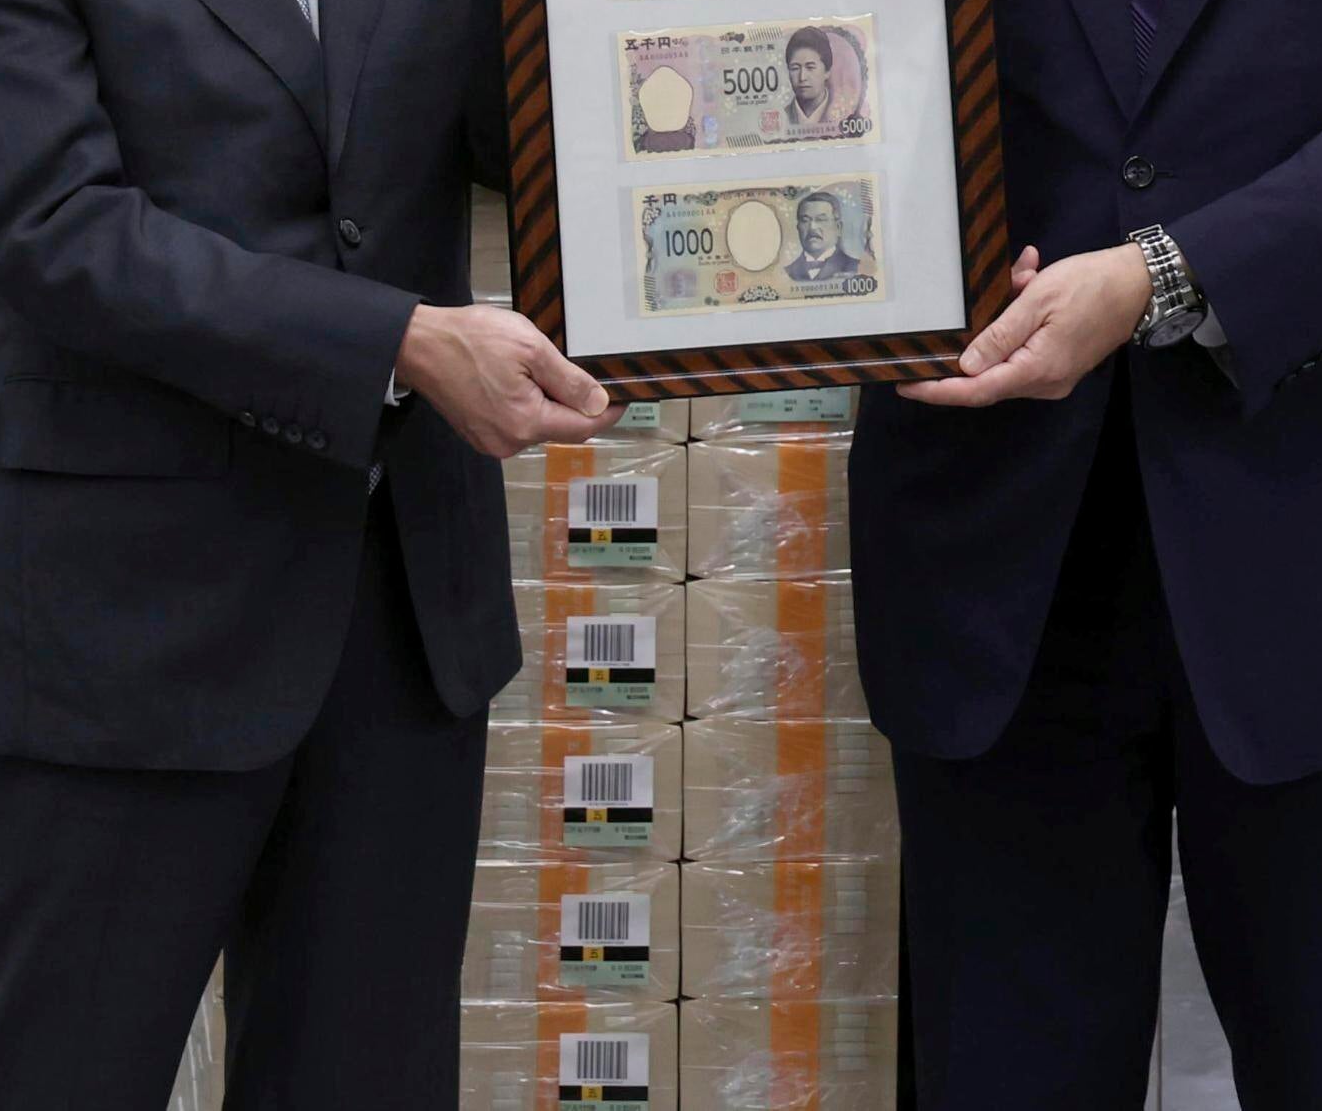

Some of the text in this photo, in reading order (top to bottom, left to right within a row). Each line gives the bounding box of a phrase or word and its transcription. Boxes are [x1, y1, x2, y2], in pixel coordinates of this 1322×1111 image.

[722, 65, 779, 95] 5000
[841, 117, 871, 133] 5000
[665, 227, 714, 258] 1000
[846, 277, 874, 293] 1000
